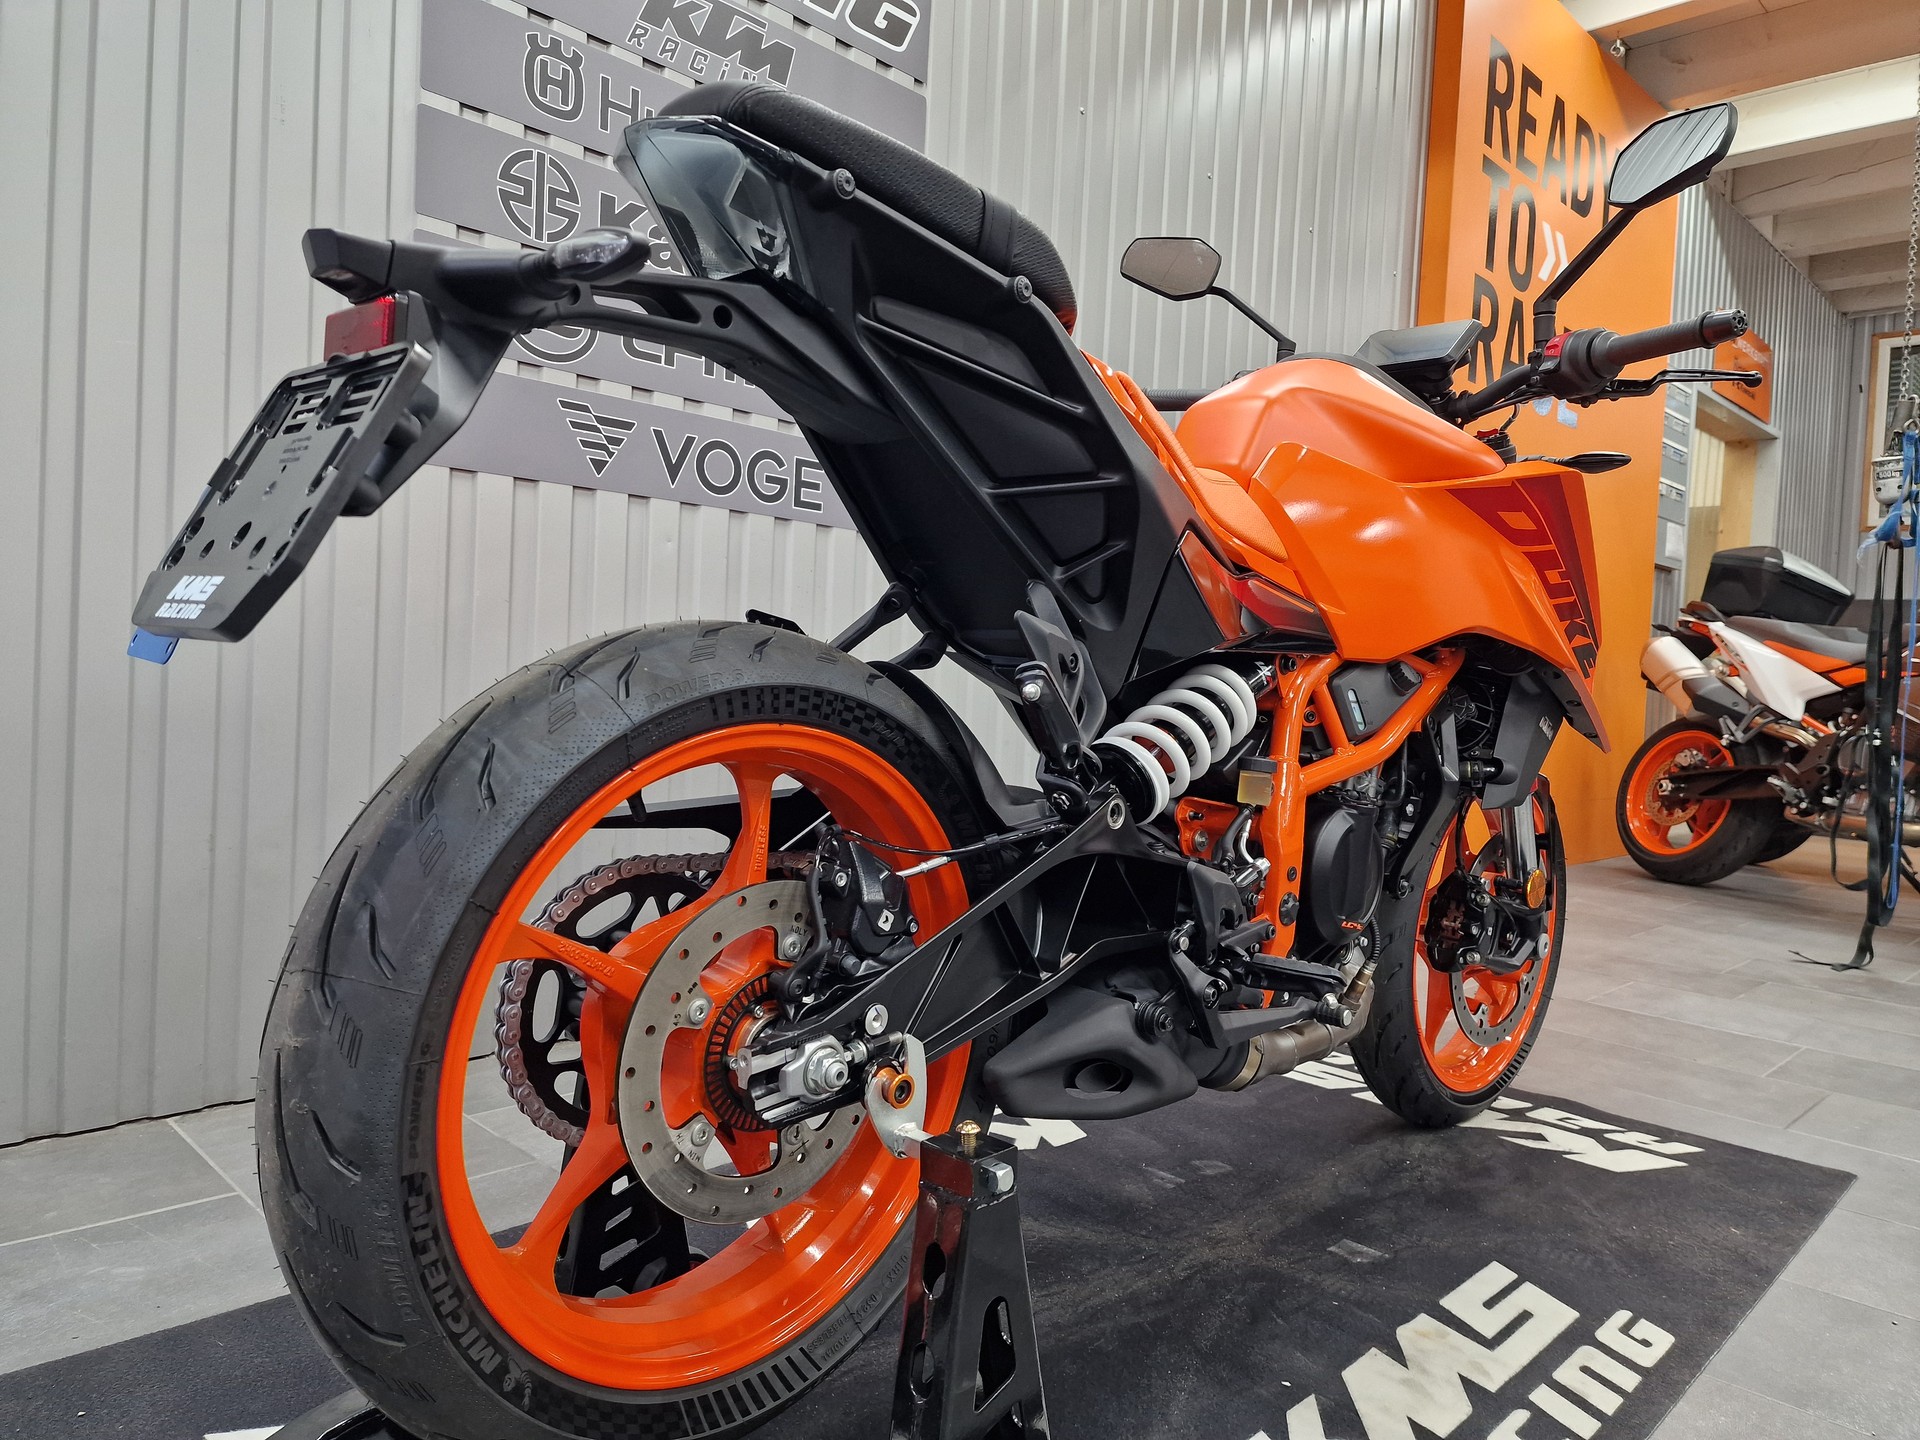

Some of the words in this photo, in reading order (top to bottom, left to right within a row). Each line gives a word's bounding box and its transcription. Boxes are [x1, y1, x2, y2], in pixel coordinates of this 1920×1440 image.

[636, 0, 796, 86] KTM
[1481, 153, 1537, 293] TO
[650, 427, 823, 512] VOGE
[1447, 480, 1600, 680] DUKE
[409, 1196, 502, 1375] MICHELIN
